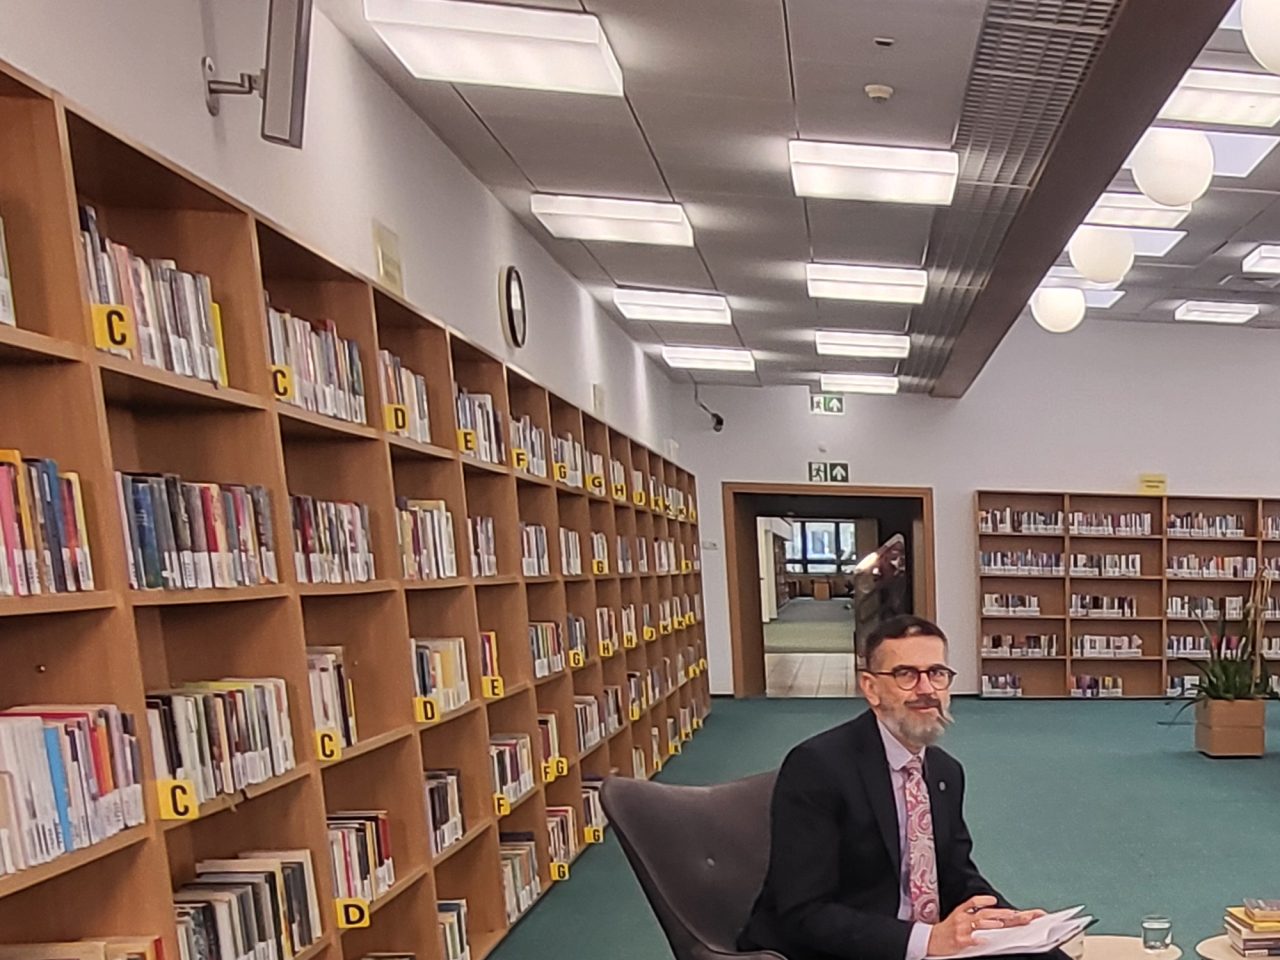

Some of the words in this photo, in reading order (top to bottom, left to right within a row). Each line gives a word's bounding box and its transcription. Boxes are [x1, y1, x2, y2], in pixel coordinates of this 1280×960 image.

[106, 310, 127, 346] C
[273, 369, 288, 396] C
[394, 408, 406, 428] D
[464, 433, 473, 450] E
[516, 453, 526, 467] F
[558, 465, 567, 480] G
[591, 476, 602, 488] G
[615, 485, 624, 496] H
[596, 561, 604, 573] G
[626, 636, 633, 646] H
[603, 643, 610, 656] H
[573, 652, 581, 666] G
[491, 679, 500, 696] E
[424, 701, 435, 721] D
[321, 733, 336, 758] C
[544, 765, 550, 780] F
[556, 760, 565, 775] G
[171, 785, 190, 816] C
[497, 799, 504, 812] F
[593, 829, 601, 842] G
[557, 864, 566, 879] G
[344, 904, 365, 925] D
